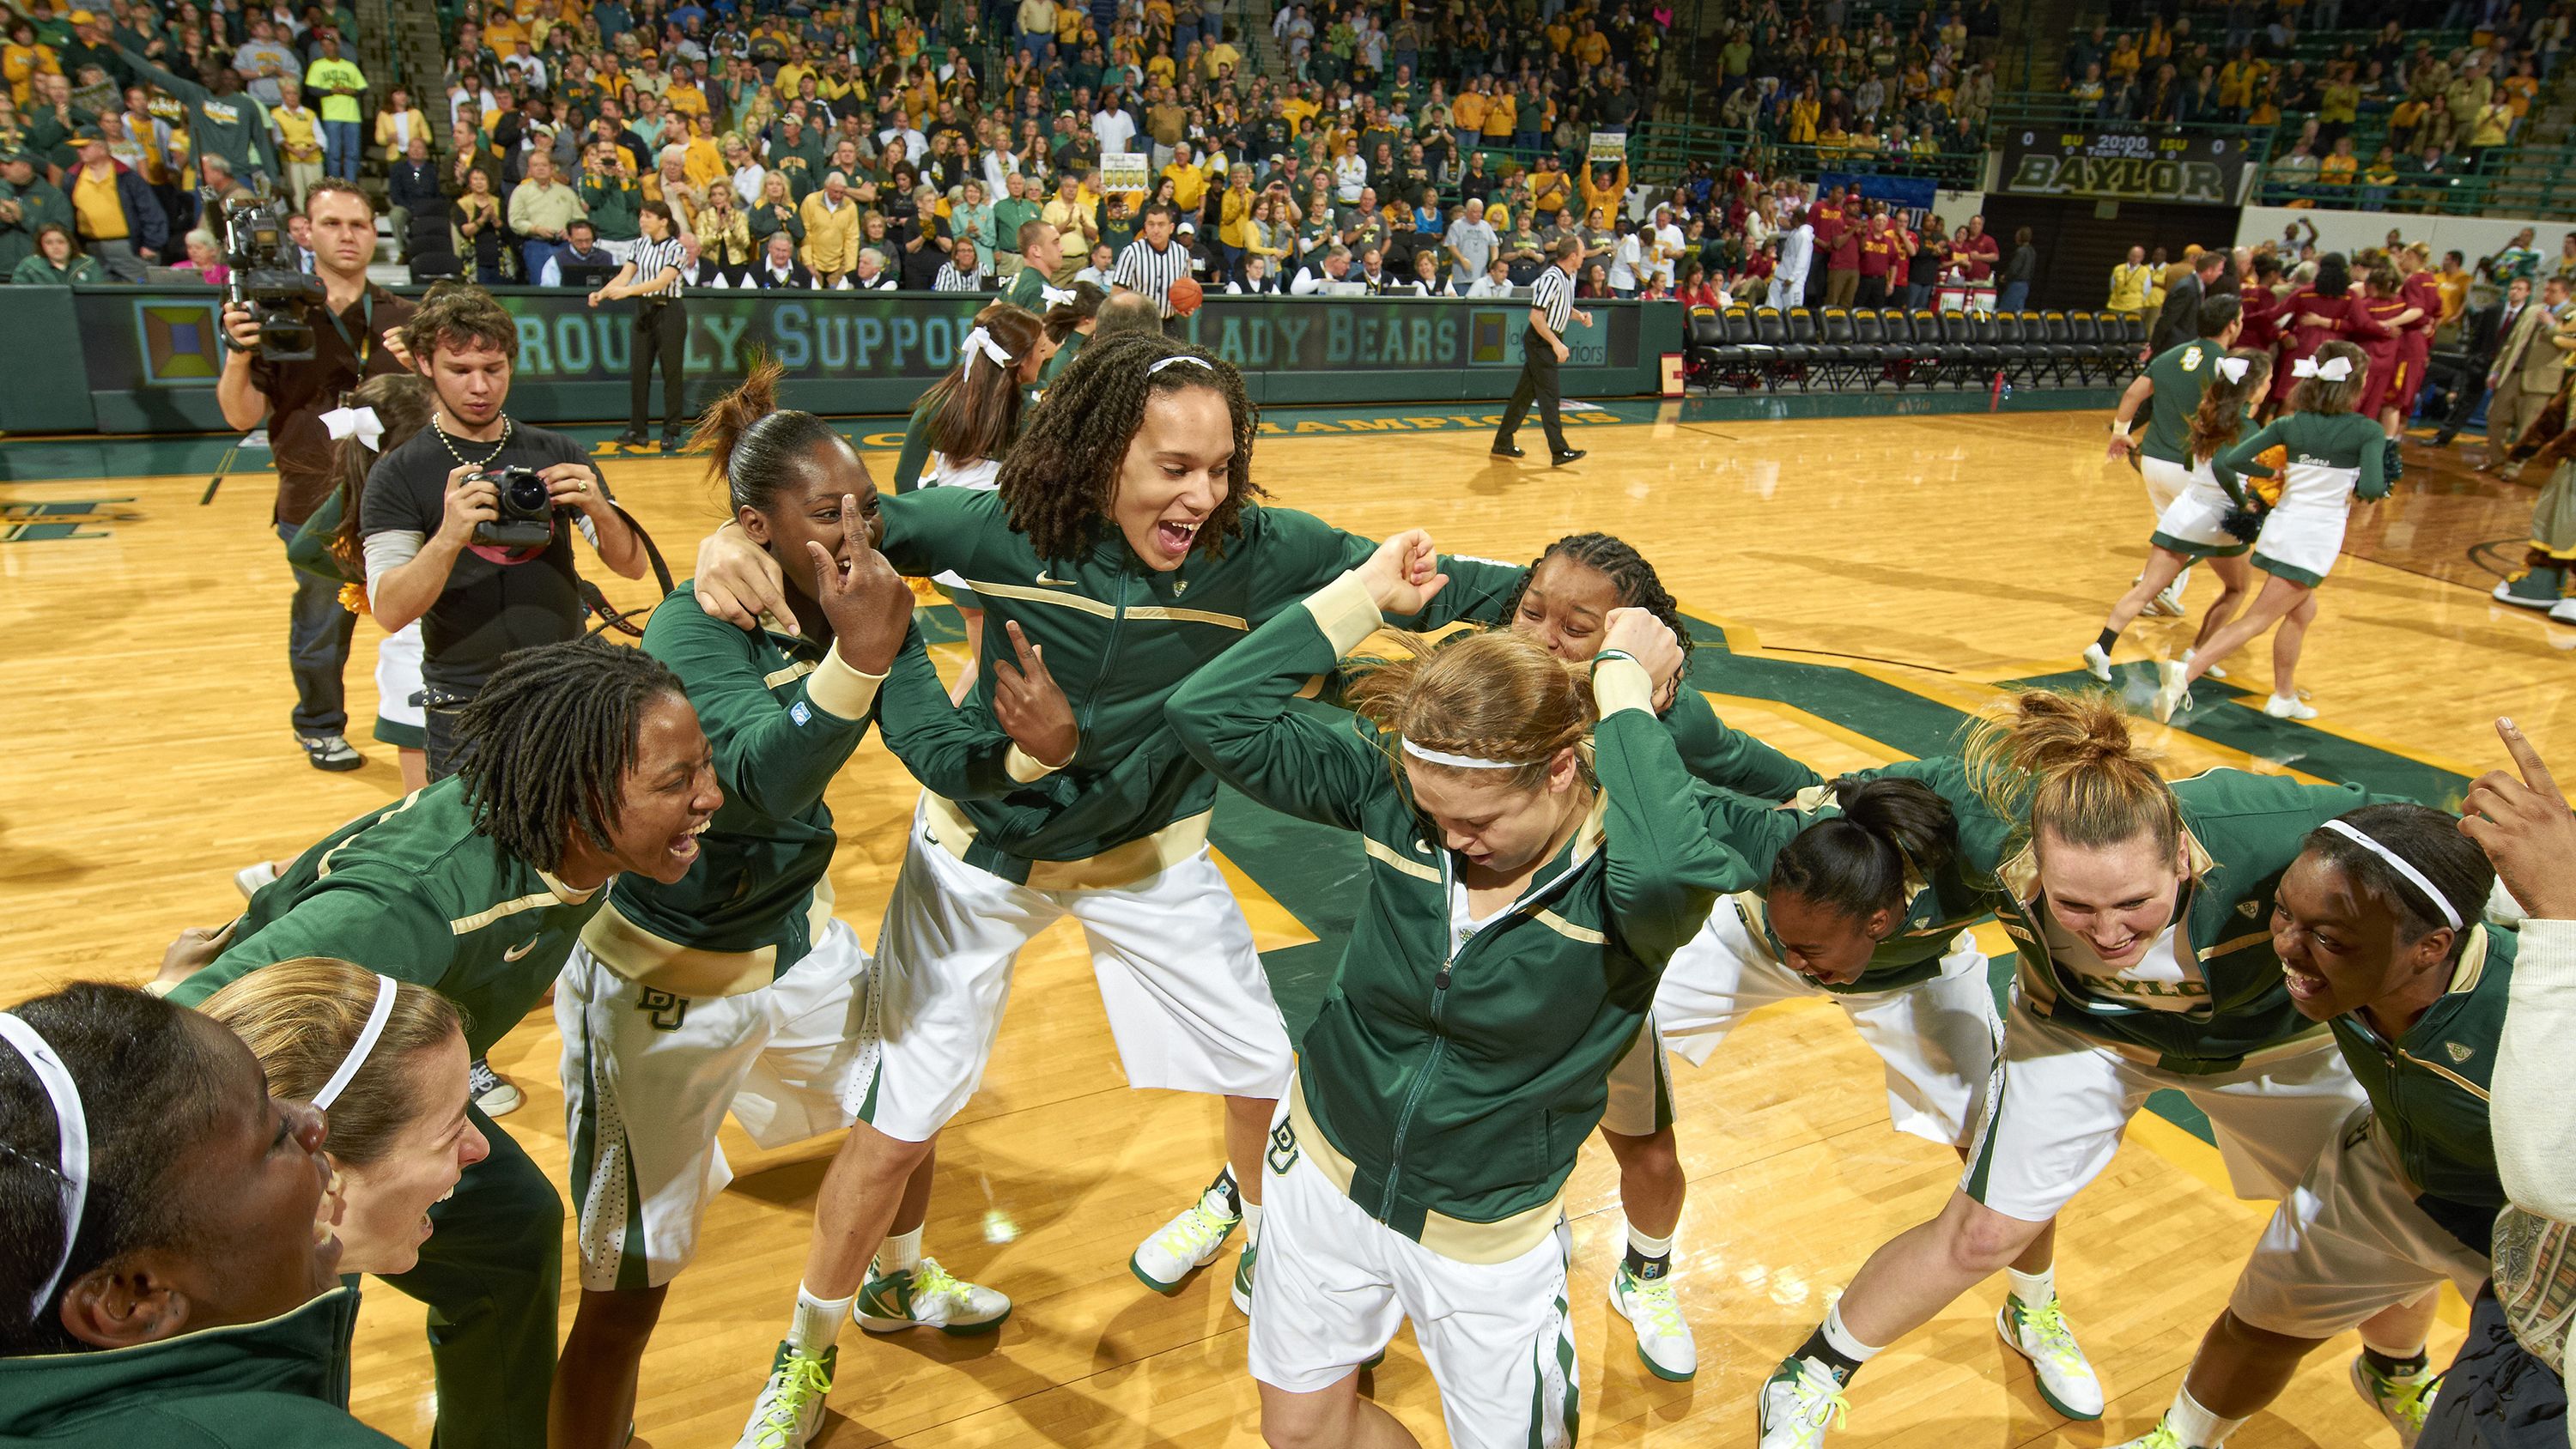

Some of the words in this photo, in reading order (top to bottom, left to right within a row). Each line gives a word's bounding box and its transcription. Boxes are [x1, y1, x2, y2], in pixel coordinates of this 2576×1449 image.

[2022, 130, 2035, 147] 0
[2061, 134, 2084, 147] BU
[2098, 134, 2149, 150] 20:00
[2159, 138, 2189, 151] ISU
[2211, 139, 2226, 155] 0
[2008, 154, 2225, 203] BAYLOR
[774, 303, 973, 370] SUPPO
[1327, 306, 1457, 364] BEARS
[2298, 453, 2330, 468] Bears
[634, 985, 690, 1034] BU
[1265, 1113, 1299, 1177] BU
